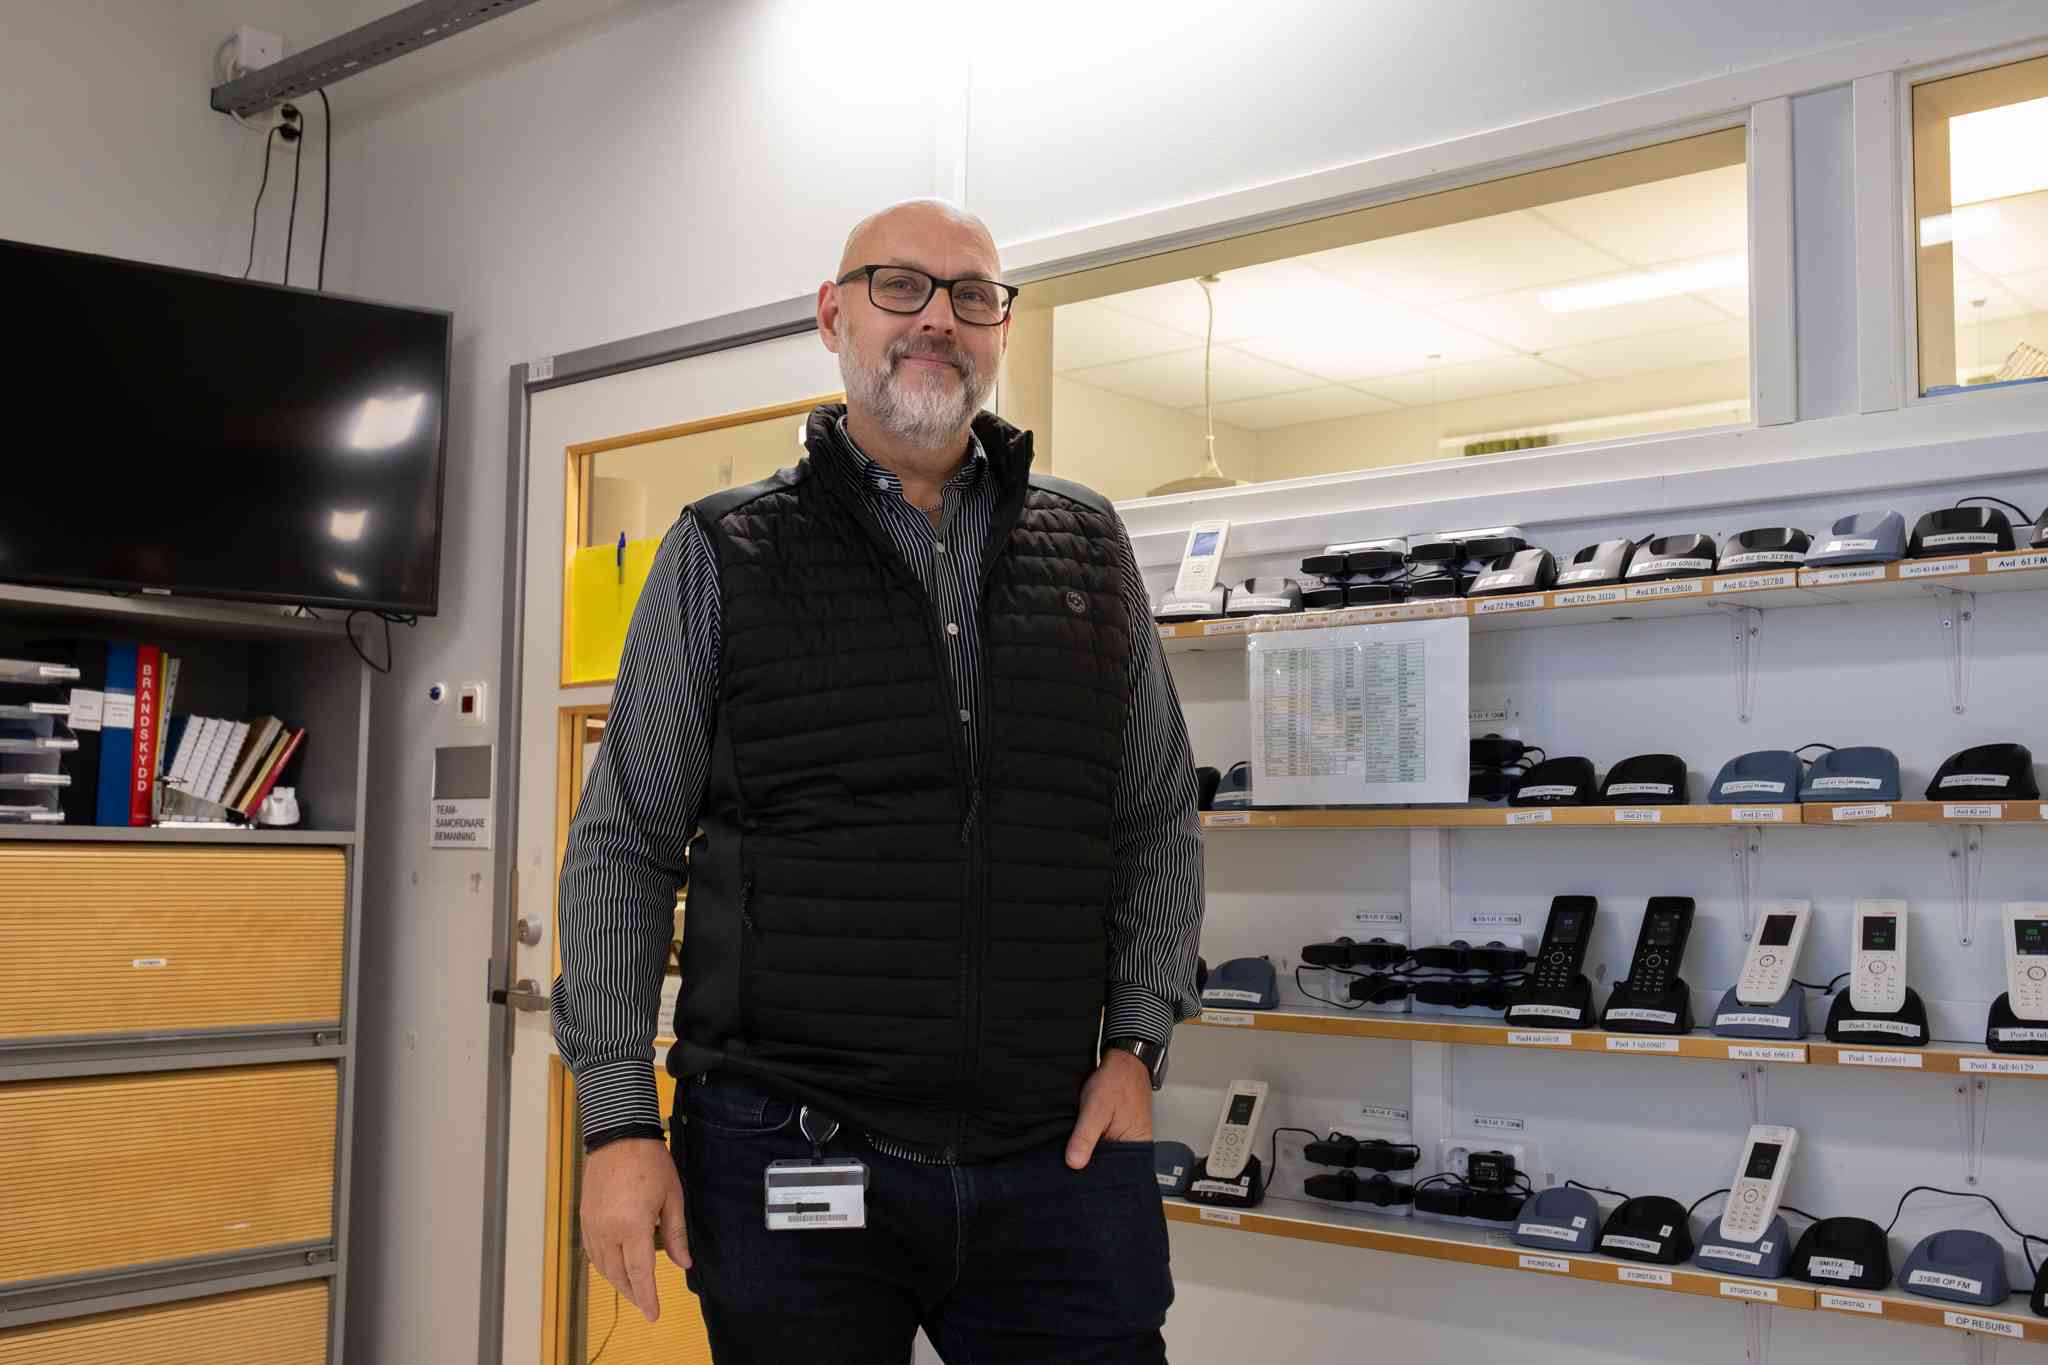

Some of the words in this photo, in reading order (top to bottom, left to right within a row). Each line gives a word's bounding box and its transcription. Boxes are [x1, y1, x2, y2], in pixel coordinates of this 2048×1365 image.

[137, 664, 152, 792] BRANDSKYDD
[1956, 1280, 1971, 1289] FM
[1955, 1316, 1970, 1326] OP
[1971, 1319, 2012, 1333] RESURS
